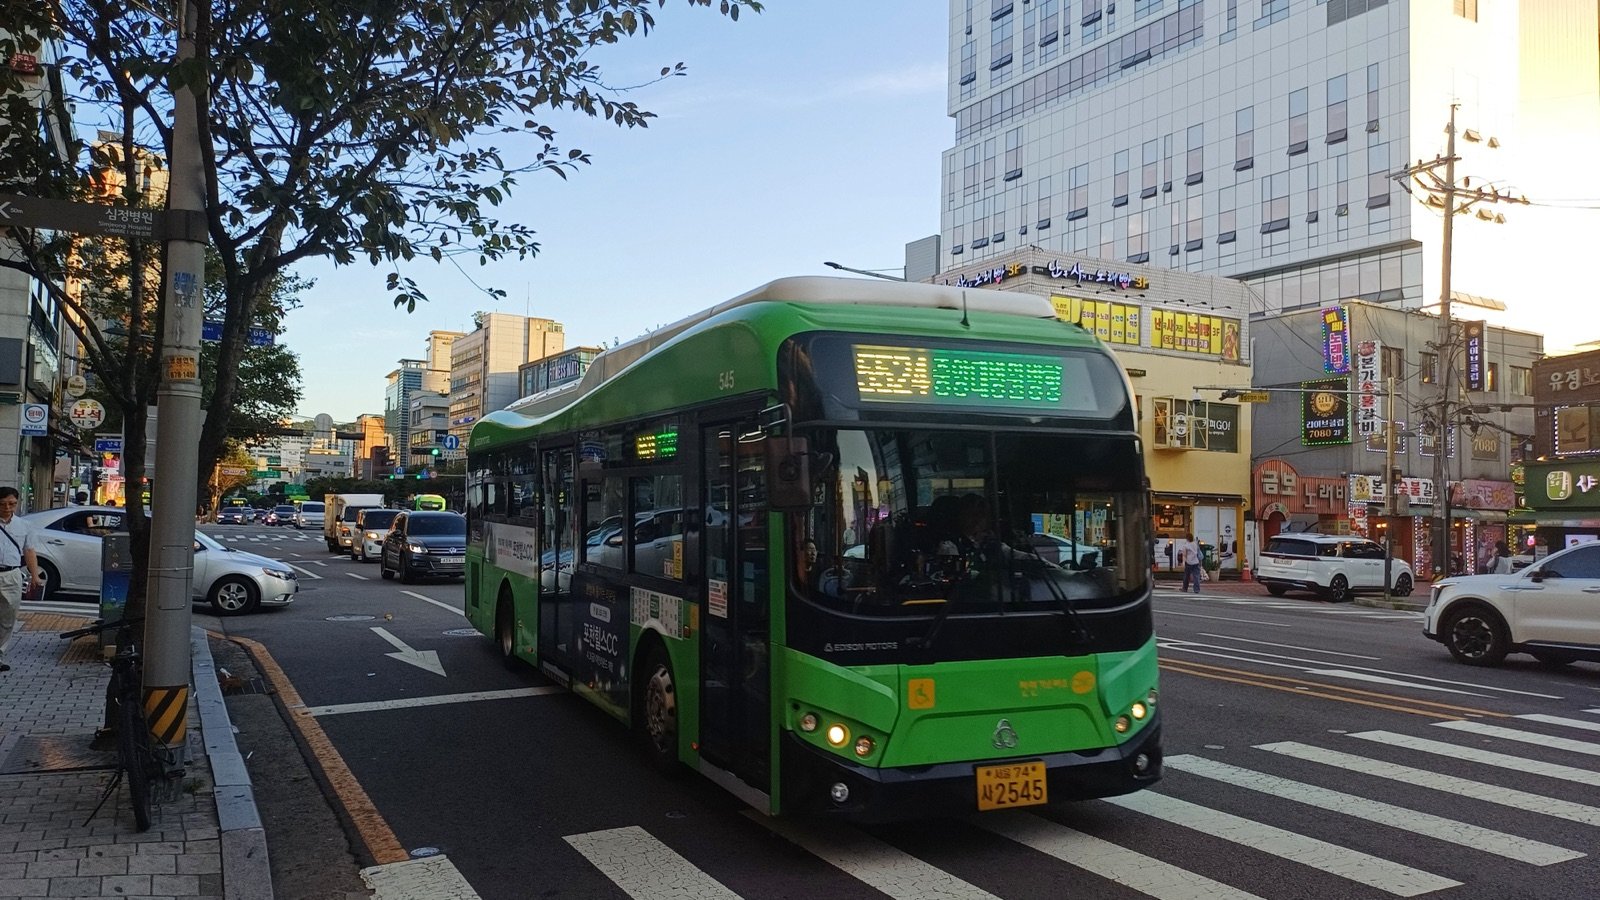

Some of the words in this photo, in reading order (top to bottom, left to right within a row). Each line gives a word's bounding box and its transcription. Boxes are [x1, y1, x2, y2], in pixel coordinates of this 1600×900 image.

[105, 207, 153, 224] 심정병원
[1212, 327, 1220, 336] 3F
[719, 371, 734, 391] 545
[72, 409, 102, 421] 보석
[1309, 429, 1332, 438] 7080
[1474, 438, 1497, 453] 7080
[834, 643, 864, 651] EDISON
